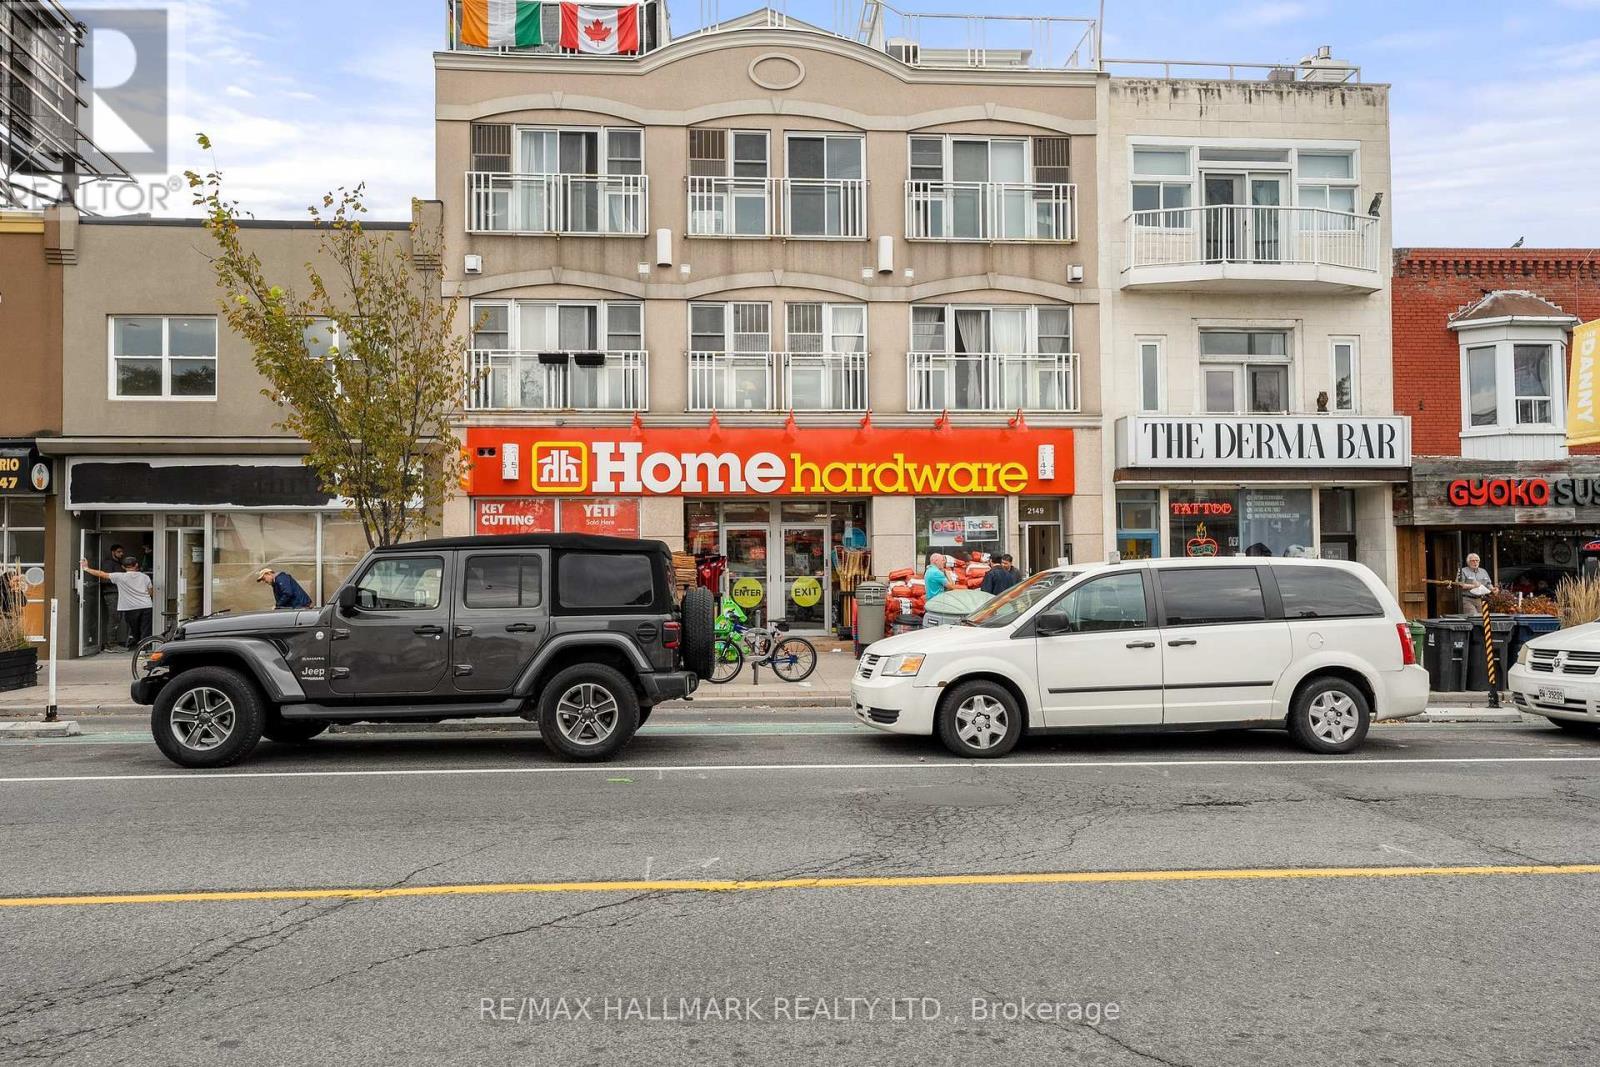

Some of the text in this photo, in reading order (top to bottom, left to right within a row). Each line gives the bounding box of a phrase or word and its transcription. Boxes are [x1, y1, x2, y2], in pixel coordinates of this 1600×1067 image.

[1577, 337, 1596, 424] DANNY
[1143, 422, 1396, 459] THE DERMA BAR
[591, 441, 786, 493] Home
[790, 452, 1029, 493] hardware
[1449, 478, 1550, 507] GYOKO
[481, 503, 505, 514] KEY
[583, 504, 616, 517] YETI
[1171, 502, 1232, 515] TATTOO
[481, 515, 535, 526] CUTTING
[586, 518, 600, 526] Sold
[931, 520, 964, 533] OPEN
[967, 520, 994, 530] FedEx
[734, 589, 761, 597] ENTER
[794, 587, 818, 597] EXIT
[301, 667, 325, 677] Jeep
